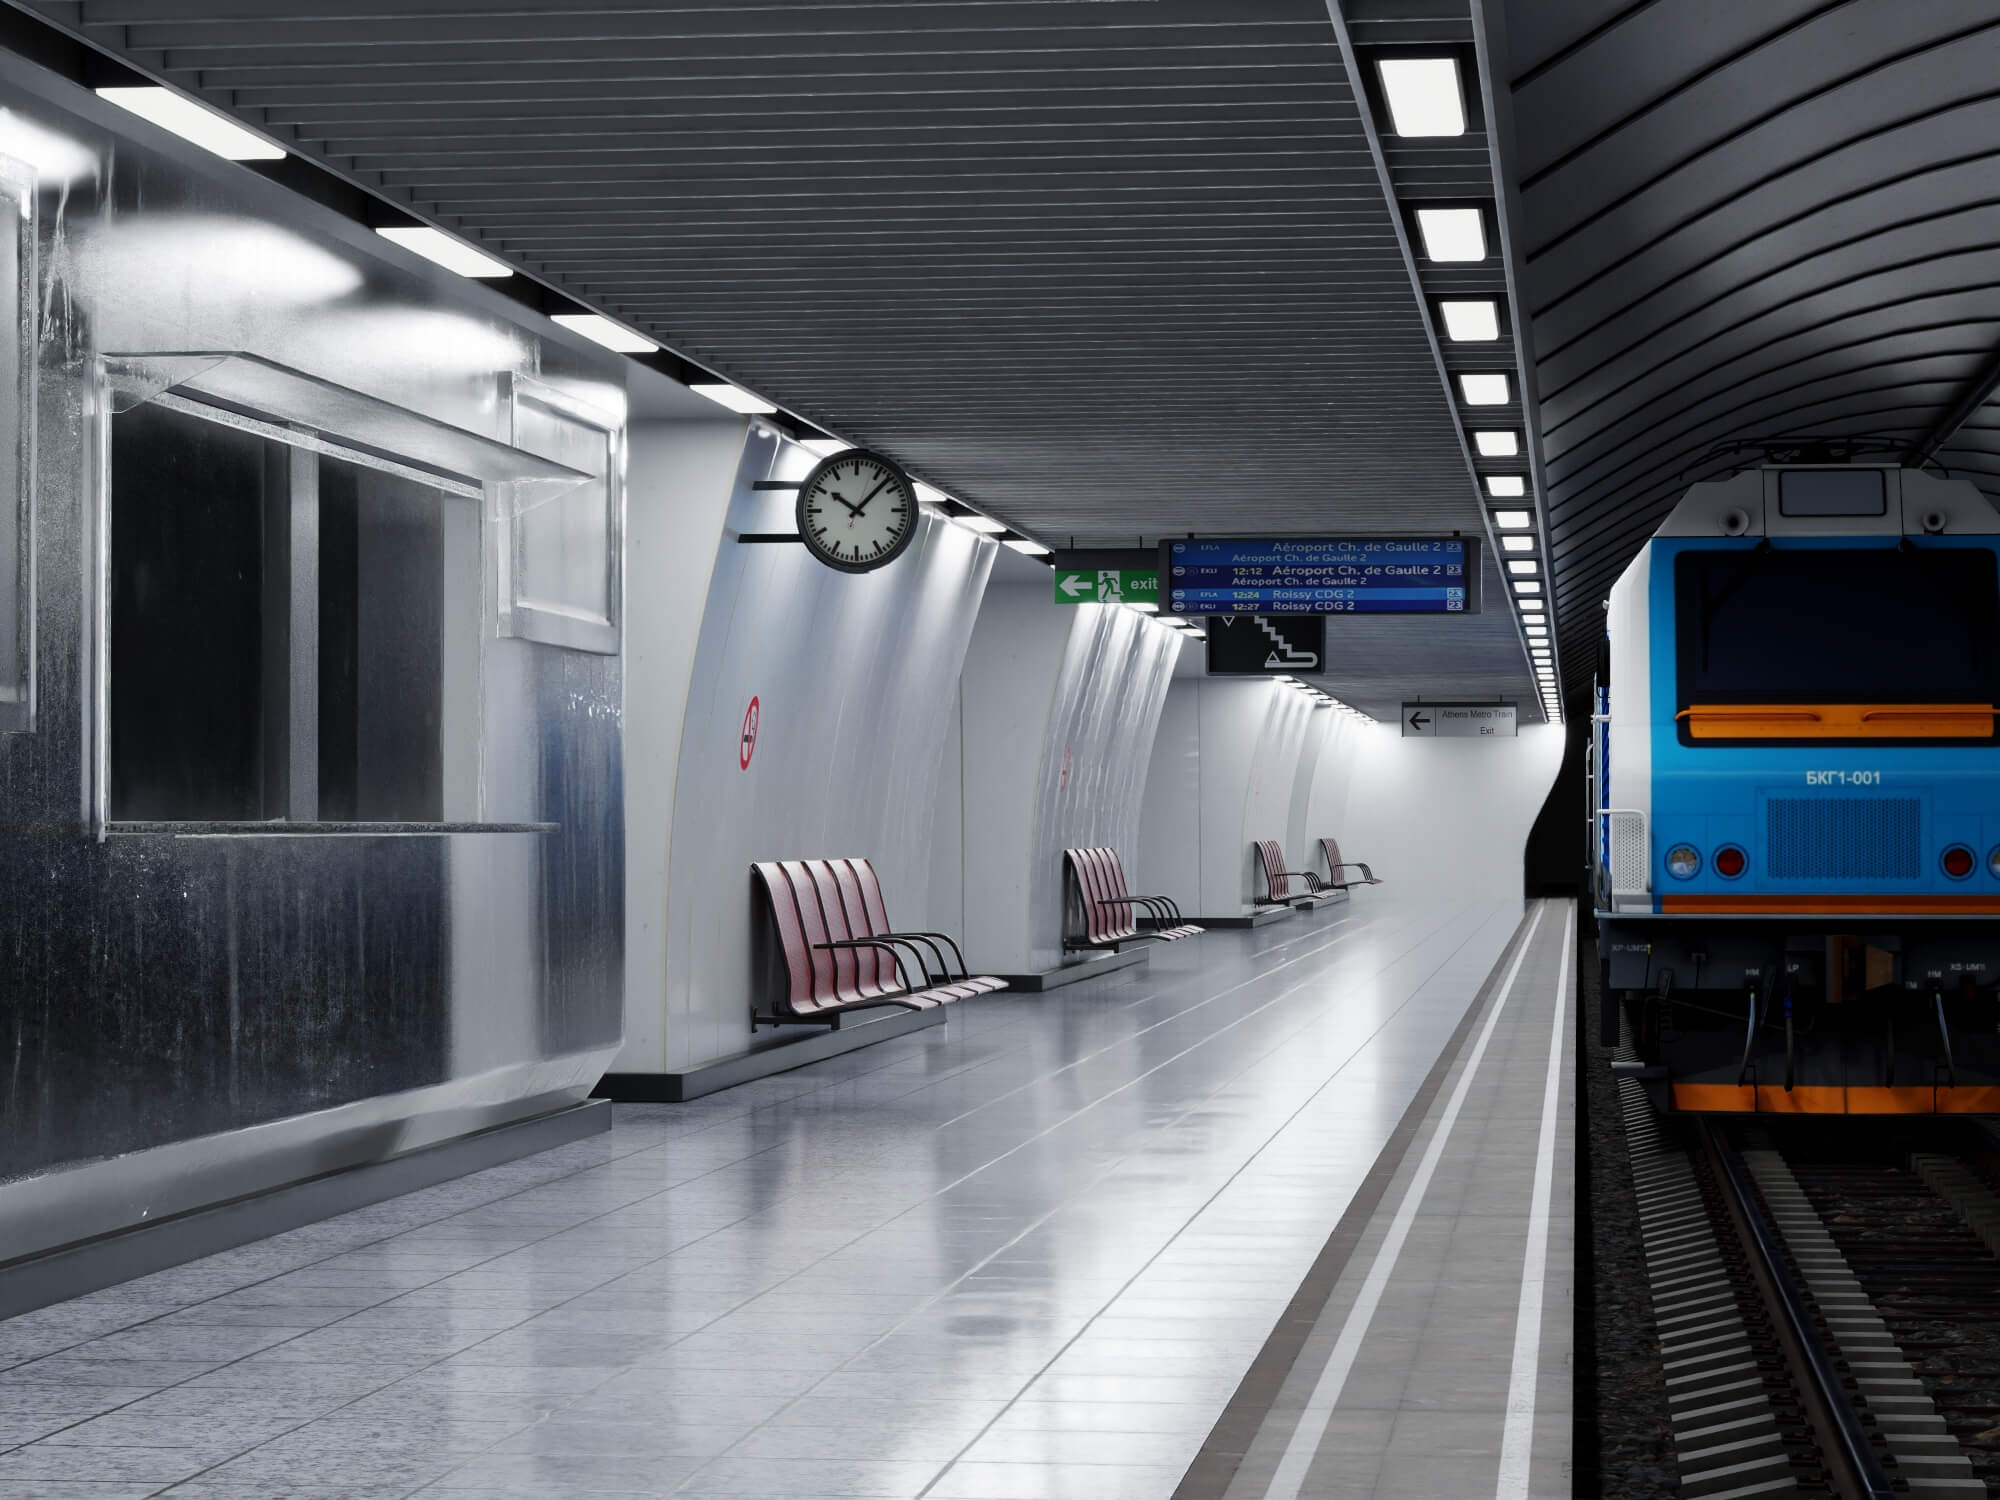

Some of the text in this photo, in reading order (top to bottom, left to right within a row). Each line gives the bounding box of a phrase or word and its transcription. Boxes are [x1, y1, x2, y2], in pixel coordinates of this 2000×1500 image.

[1272, 543, 1334, 554] Aéroport
[1338, 543, 1361, 552] Ch.
[1365, 543, 1381, 552] de
[1385, 543, 1429, 552] Gaulle
[1433, 543, 1441, 552] 2
[1232, 554, 1367, 563] Aéroport Ch. de Gaulle 2
[1232, 567, 1263, 575] 12:12
[1272, 566, 1334, 577] Aéroport
[1338, 566, 1361, 575] Ch.
[1365, 566, 1381, 575] de
[1385, 566, 1429, 575] Gaulle
[1433, 566, 1441, 575] 2
[1130, 577, 1158, 590] exit
[1232, 577, 1367, 587] Aéroport Ch. de Gaulle 2
[1232, 591, 1260, 599] 12:24
[1272, 590, 1312, 600] Roissy
[1315, 590, 1344, 599] CDG
[1347, 590, 1354, 599] 2
[1232, 603, 1260, 611] 12:27
[1272, 602, 1312, 612] Roissy
[1315, 602, 1344, 611] CDG
[1347, 602, 1354, 611] 2
[1442, 710, 1513, 718] Athens Metro Train
[1480, 726, 1494, 735] Exit
[1806, 770, 1880, 785] БКГ1-001
